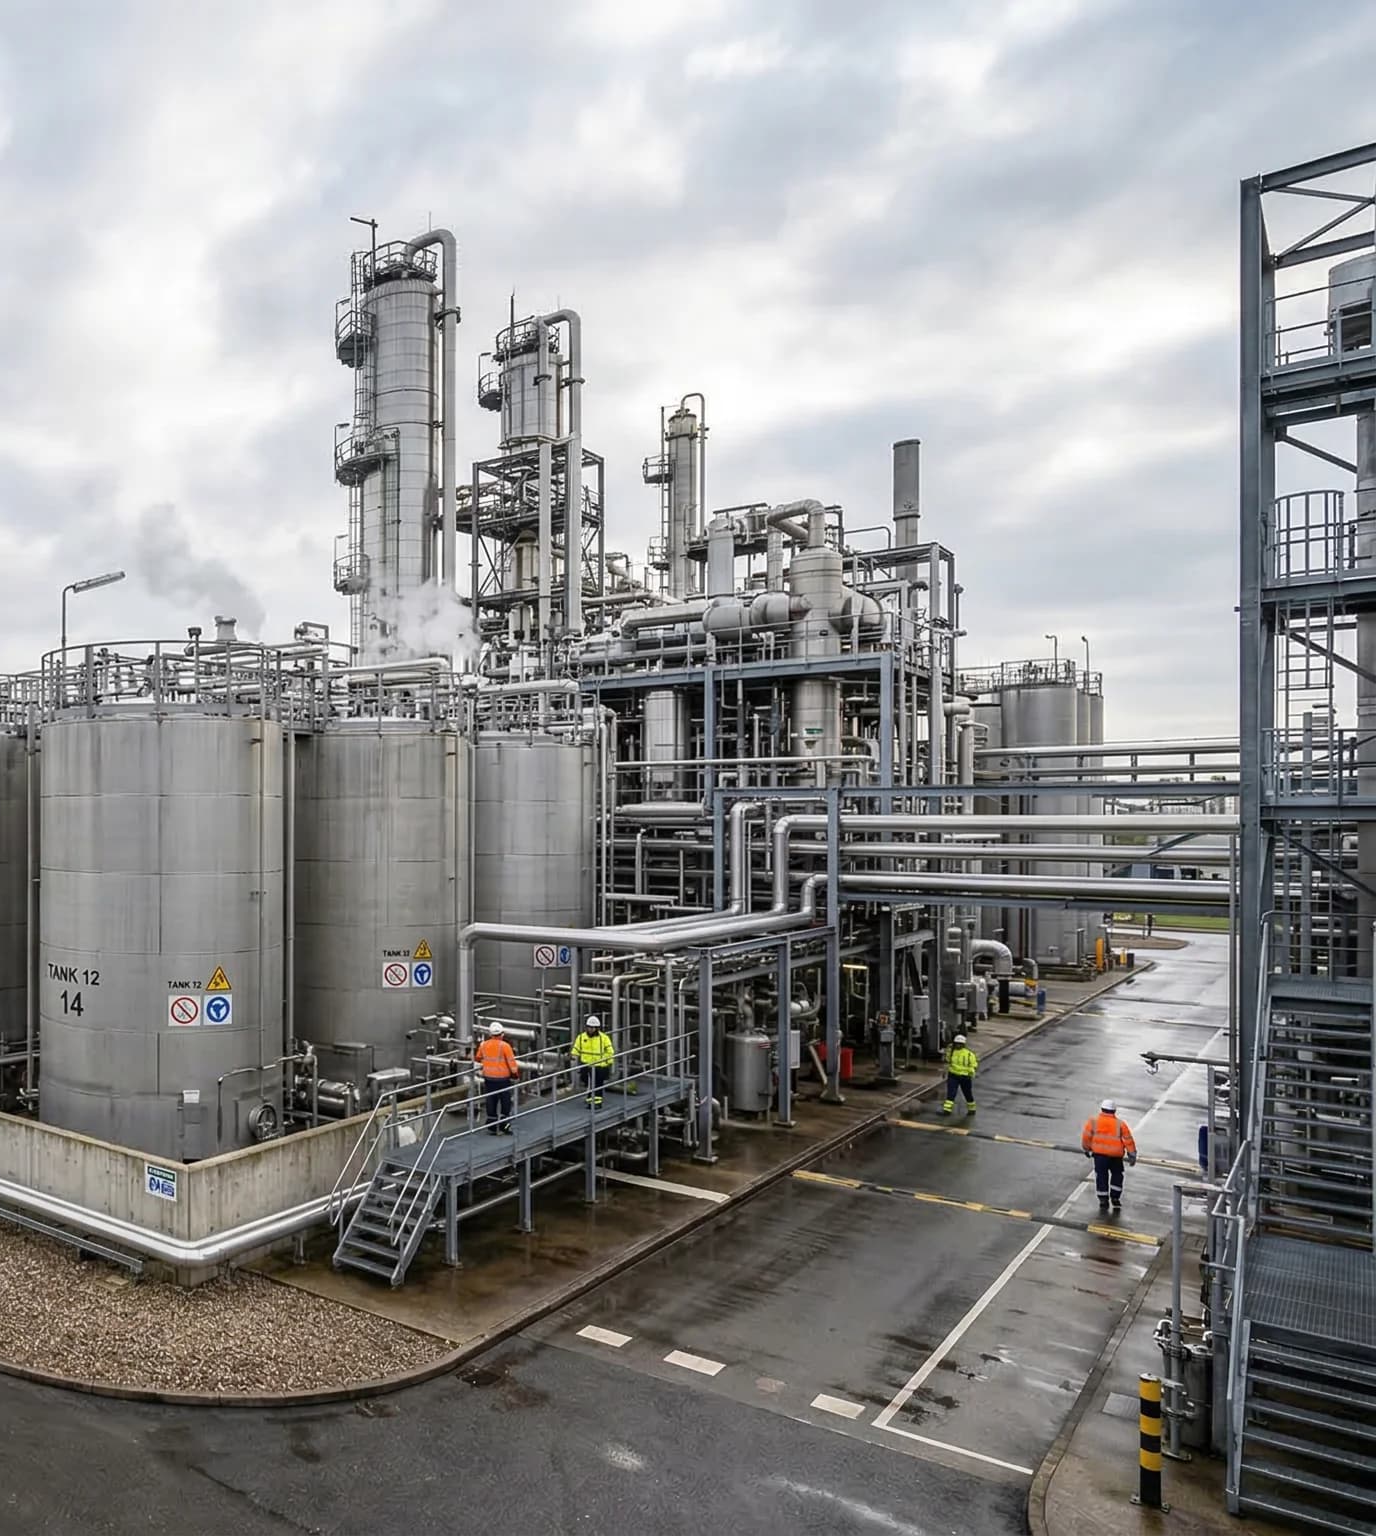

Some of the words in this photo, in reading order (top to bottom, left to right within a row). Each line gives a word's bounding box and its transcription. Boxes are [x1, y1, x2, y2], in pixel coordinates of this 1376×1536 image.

[48, 963, 79, 985] TANK
[82, 969, 100, 986] 12
[167, 980, 191, 989] TANK
[60, 990, 84, 1016] 14
